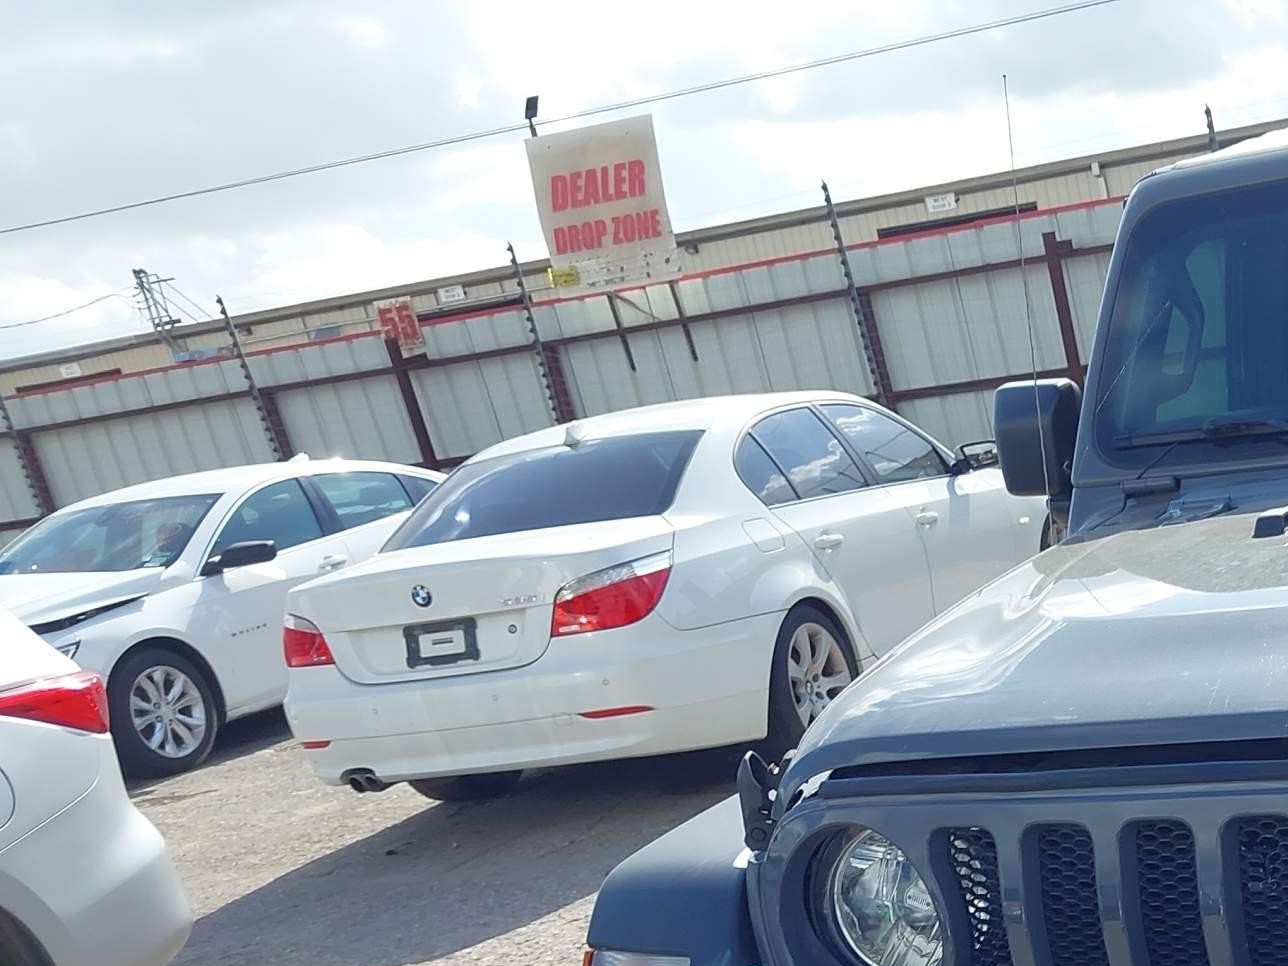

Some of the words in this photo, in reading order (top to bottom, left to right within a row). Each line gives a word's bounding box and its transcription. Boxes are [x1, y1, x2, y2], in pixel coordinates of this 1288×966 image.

[551, 159, 646, 213] DEALER
[553, 217, 608, 256] DROP
[611, 209, 662, 246] ZONE
